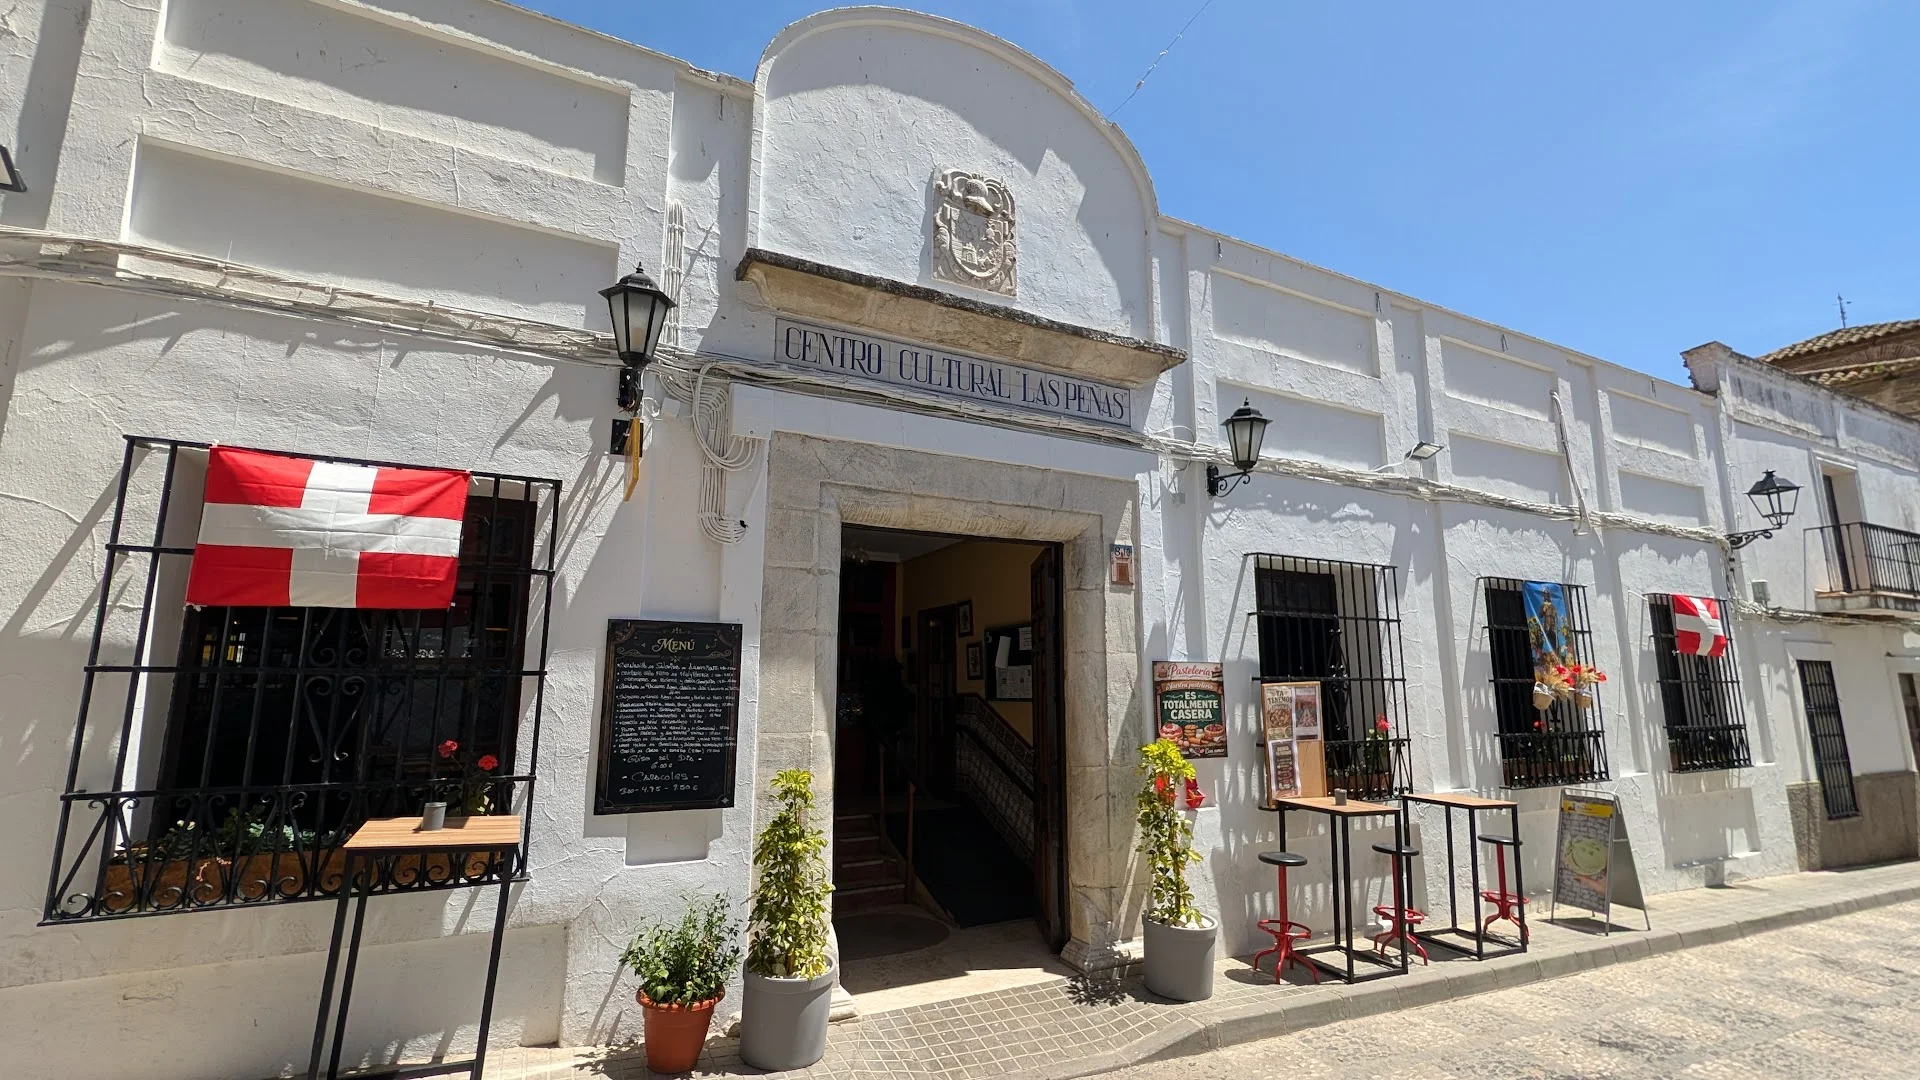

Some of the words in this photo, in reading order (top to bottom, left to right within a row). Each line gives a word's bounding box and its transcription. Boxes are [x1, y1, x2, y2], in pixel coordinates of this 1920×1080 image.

[785, 327, 882, 375] CENTRO
[898, 349, 1011, 399] CULTURAL
[652, 638, 695, 652] MENÚ
[1168, 664, 1211, 677] Pastelería
[1184, 691, 1197, 700] ES
[1162, 699, 1219, 710] TOTALMENTE
[1170, 709, 1213, 720] CASERA
